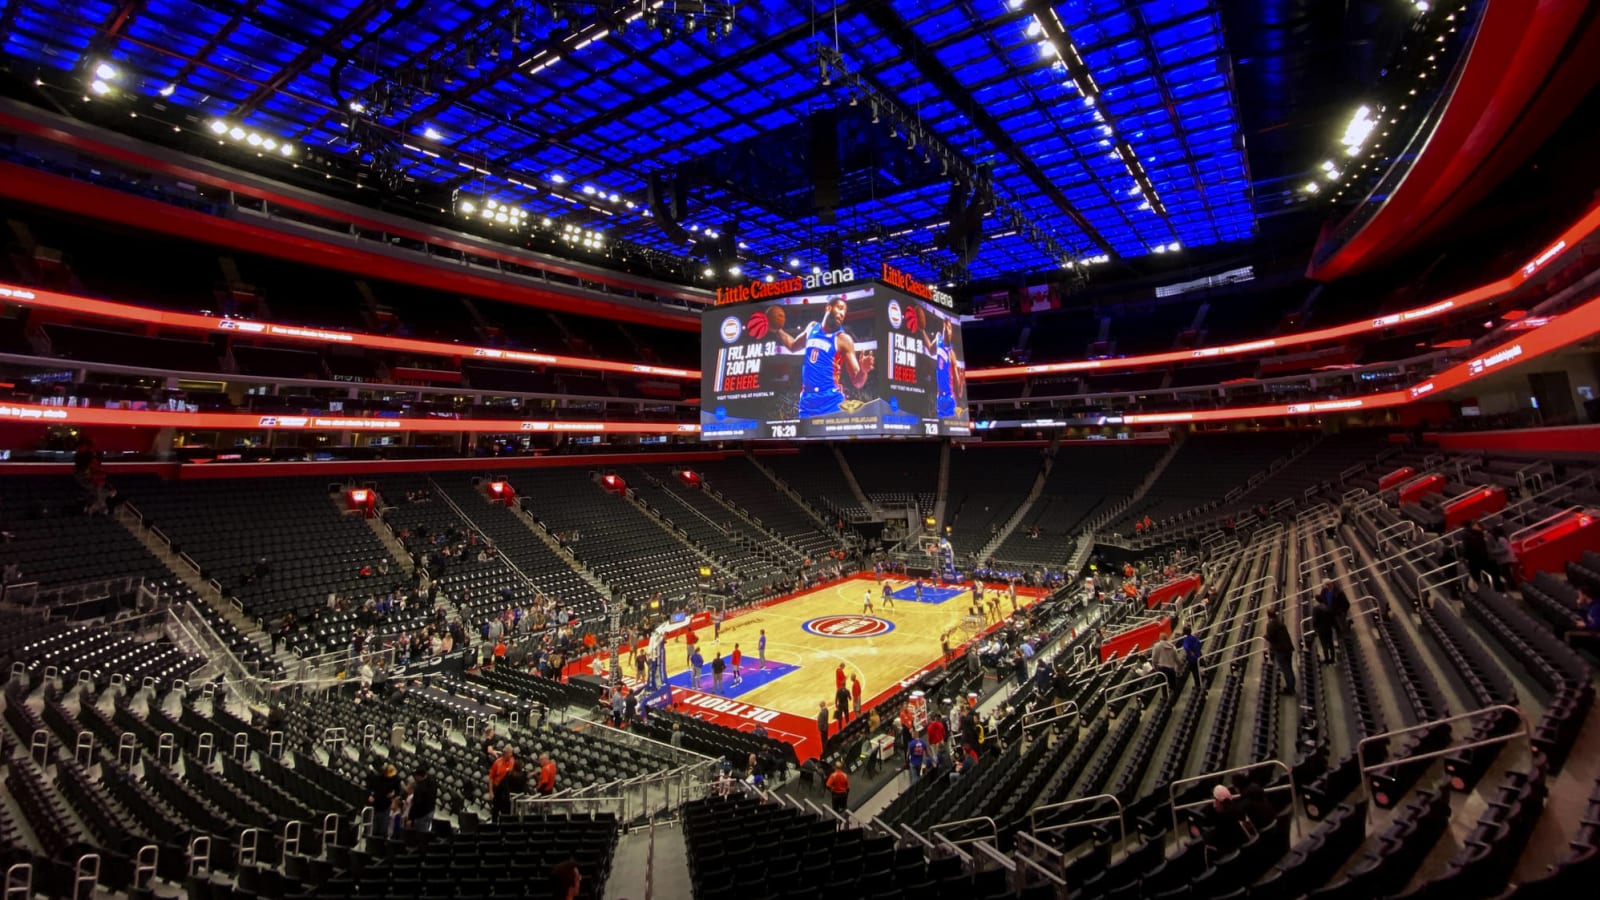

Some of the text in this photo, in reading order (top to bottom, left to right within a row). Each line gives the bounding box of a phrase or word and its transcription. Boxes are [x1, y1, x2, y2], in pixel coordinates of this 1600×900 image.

[715, 267, 854, 305] Little Caesars arena
[883, 262, 953, 308] Little Caesars arena
[745, 343, 763, 359] JAN.
[726, 358, 761, 376] 7:00 PM
[724, 376, 736, 391] BE
[683, 693, 780, 723] DETROIT
